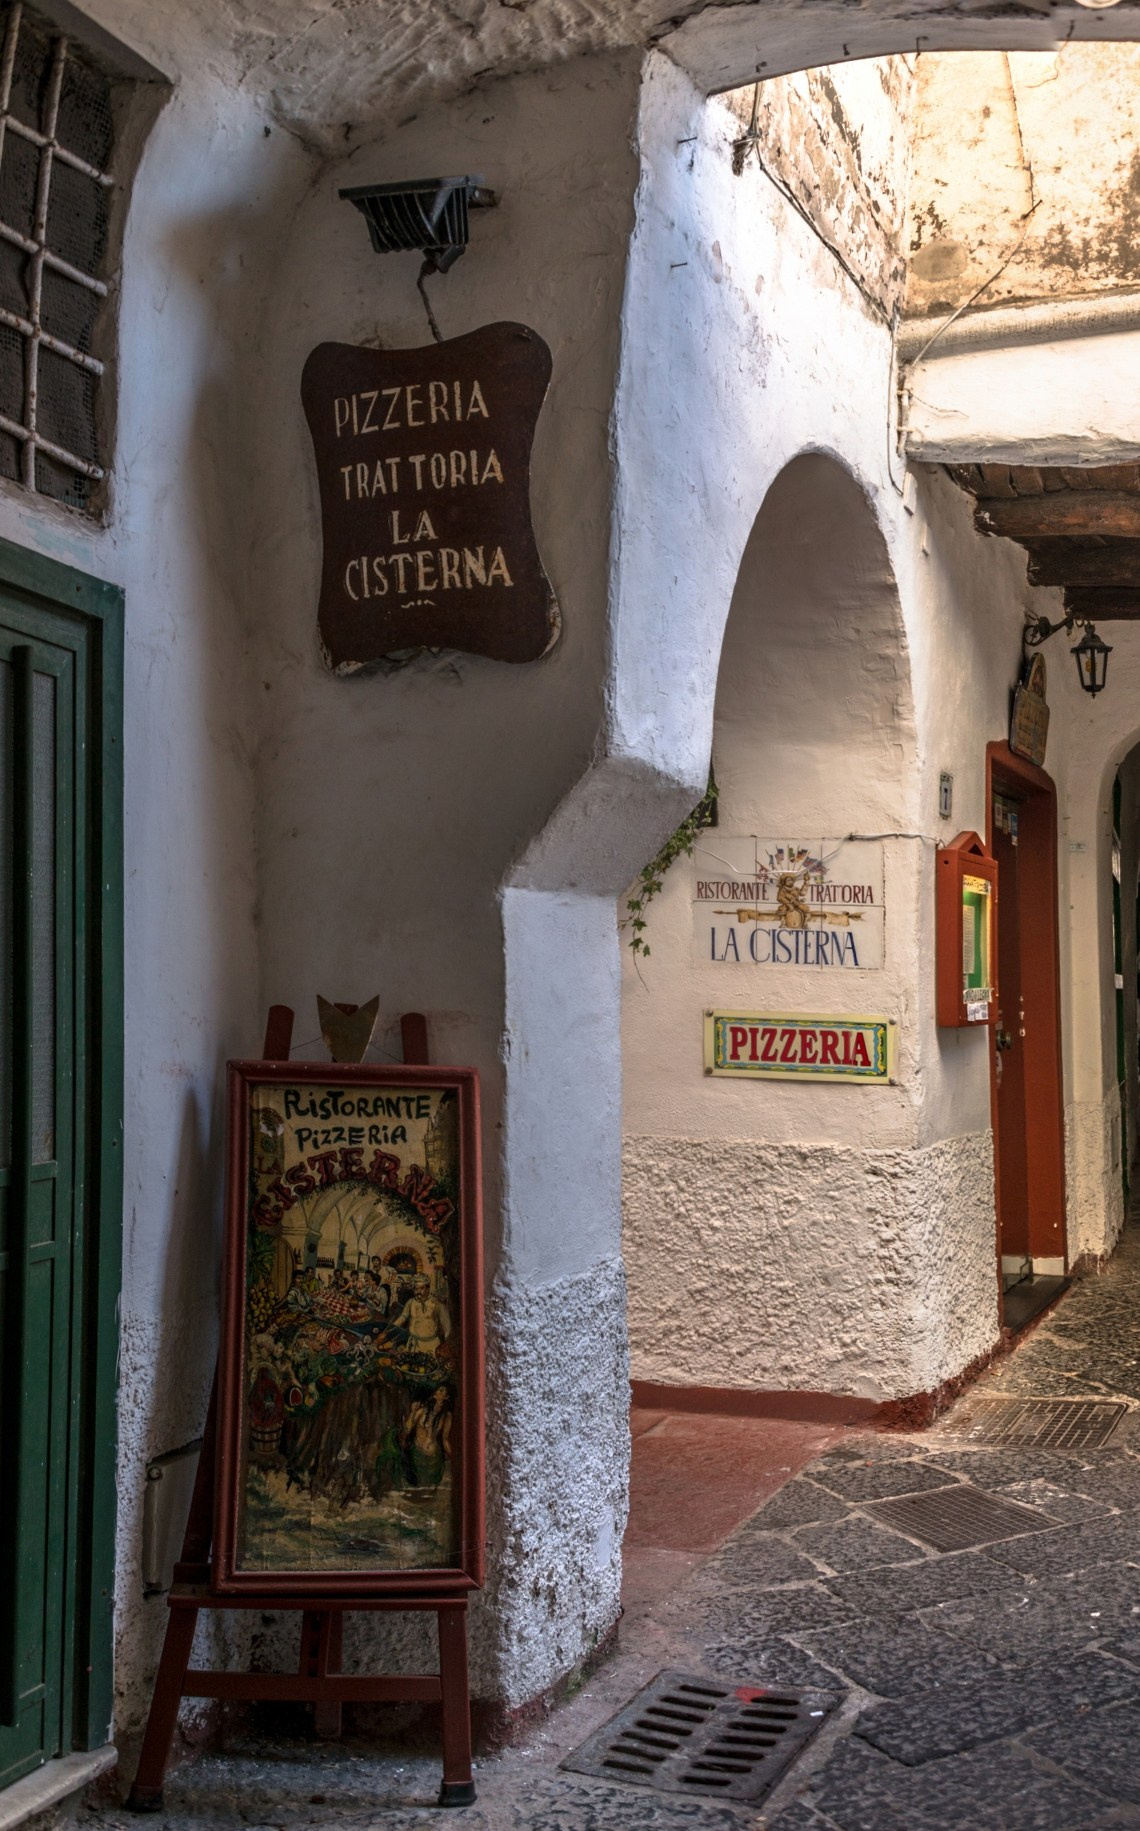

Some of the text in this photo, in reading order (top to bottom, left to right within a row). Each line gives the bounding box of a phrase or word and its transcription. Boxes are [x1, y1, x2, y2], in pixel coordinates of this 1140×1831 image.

[333, 380, 490, 438] PIZZERIA
[340, 448, 505, 500] TRATTORIA
[391, 510, 438, 545] LA
[344, 545, 515, 601] CISTERNA
[696, 881, 769, 901] RISTORANTE
[710, 926, 860, 966] LA CISTERNA
[729, 1026, 872, 1068] PIZZERIA
[256, 1156, 284, 1175] LA
[252, 1147, 456, 1234] CISTERNA
